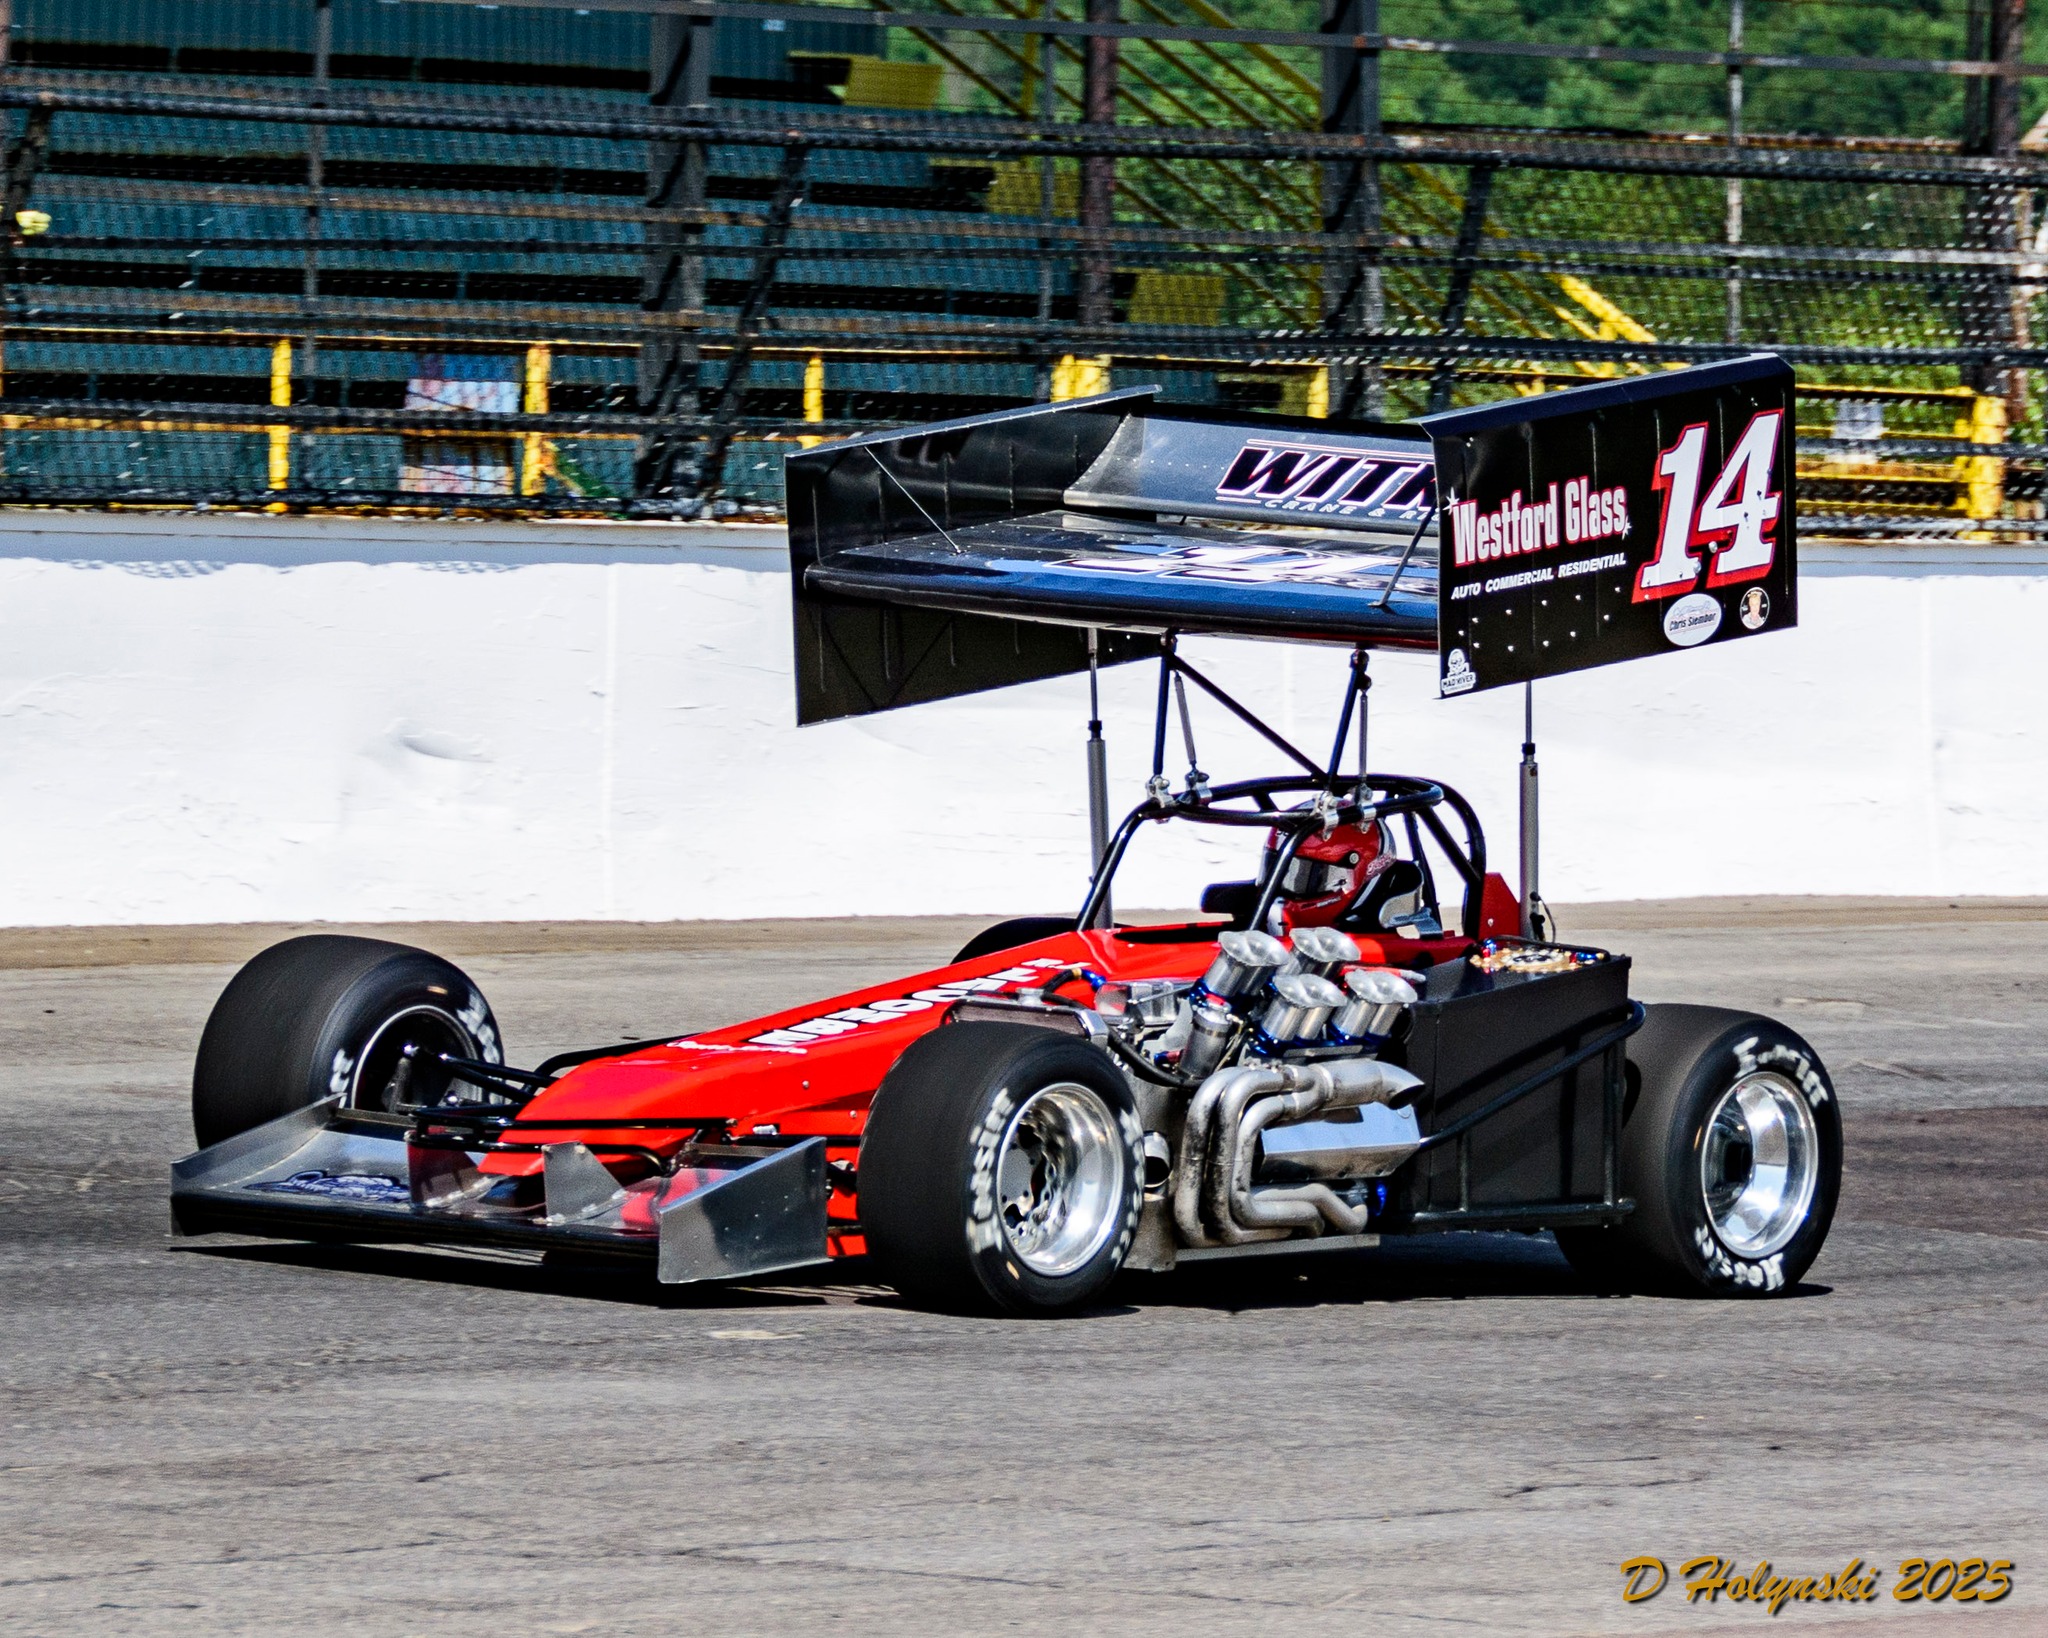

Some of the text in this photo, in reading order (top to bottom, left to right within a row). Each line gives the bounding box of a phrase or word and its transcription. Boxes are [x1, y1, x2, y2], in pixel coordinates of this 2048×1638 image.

[1264, 499, 1358, 515] CRANE
[1367, 508, 1386, 518] &
[1452, 475, 1628, 567] Westford Glass
[1633, 408, 1784, 603] 14
[1451, 552, 1627, 600] AUTO COMMERCIAL RESIDENTIAL
